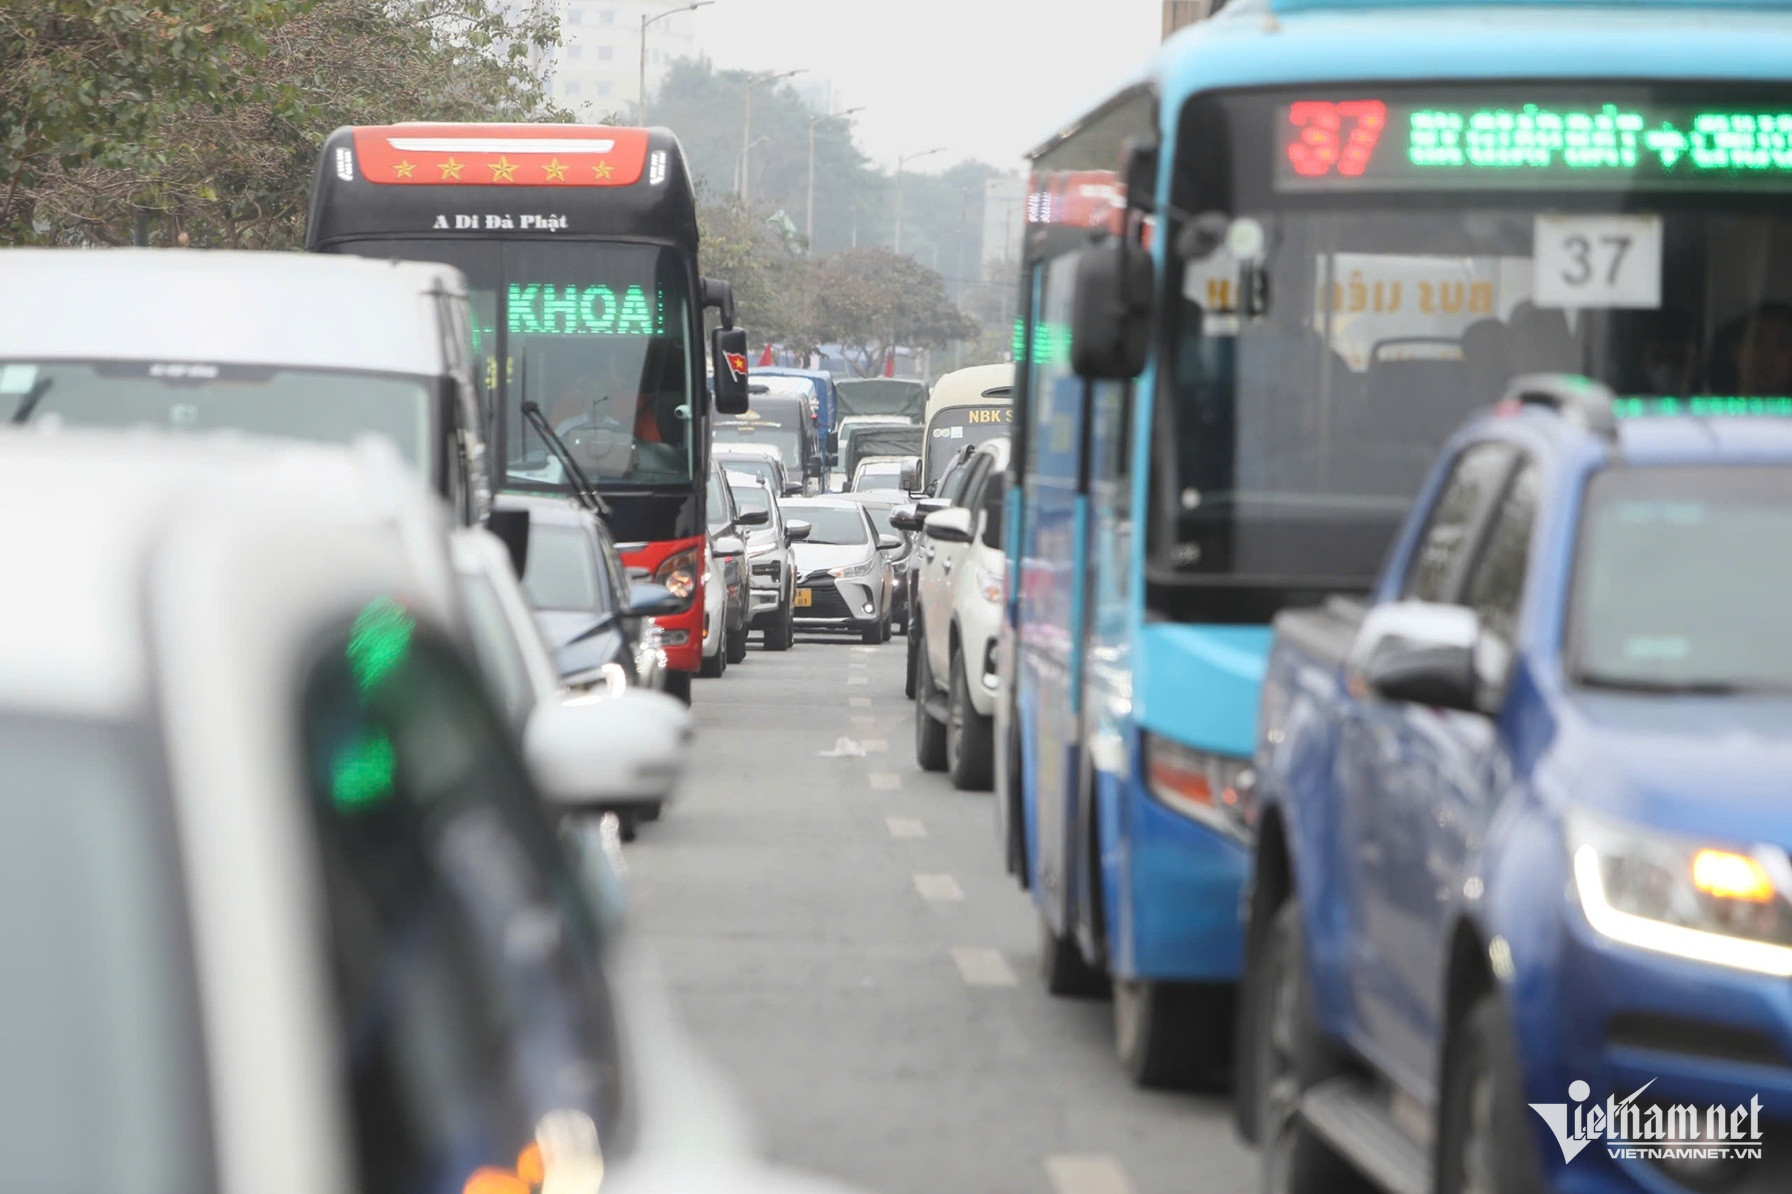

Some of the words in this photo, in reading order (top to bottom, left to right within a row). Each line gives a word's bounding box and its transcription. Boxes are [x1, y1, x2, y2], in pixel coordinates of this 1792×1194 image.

[1288, 100, 1386, 175] 37
[432, 215, 450, 229] A
[455, 214, 479, 229] Di
[485, 214, 514, 229] Đà
[519, 213, 568, 232] Phật
[1560, 233, 1633, 288] 37
[969, 410, 1001, 423] NBK
